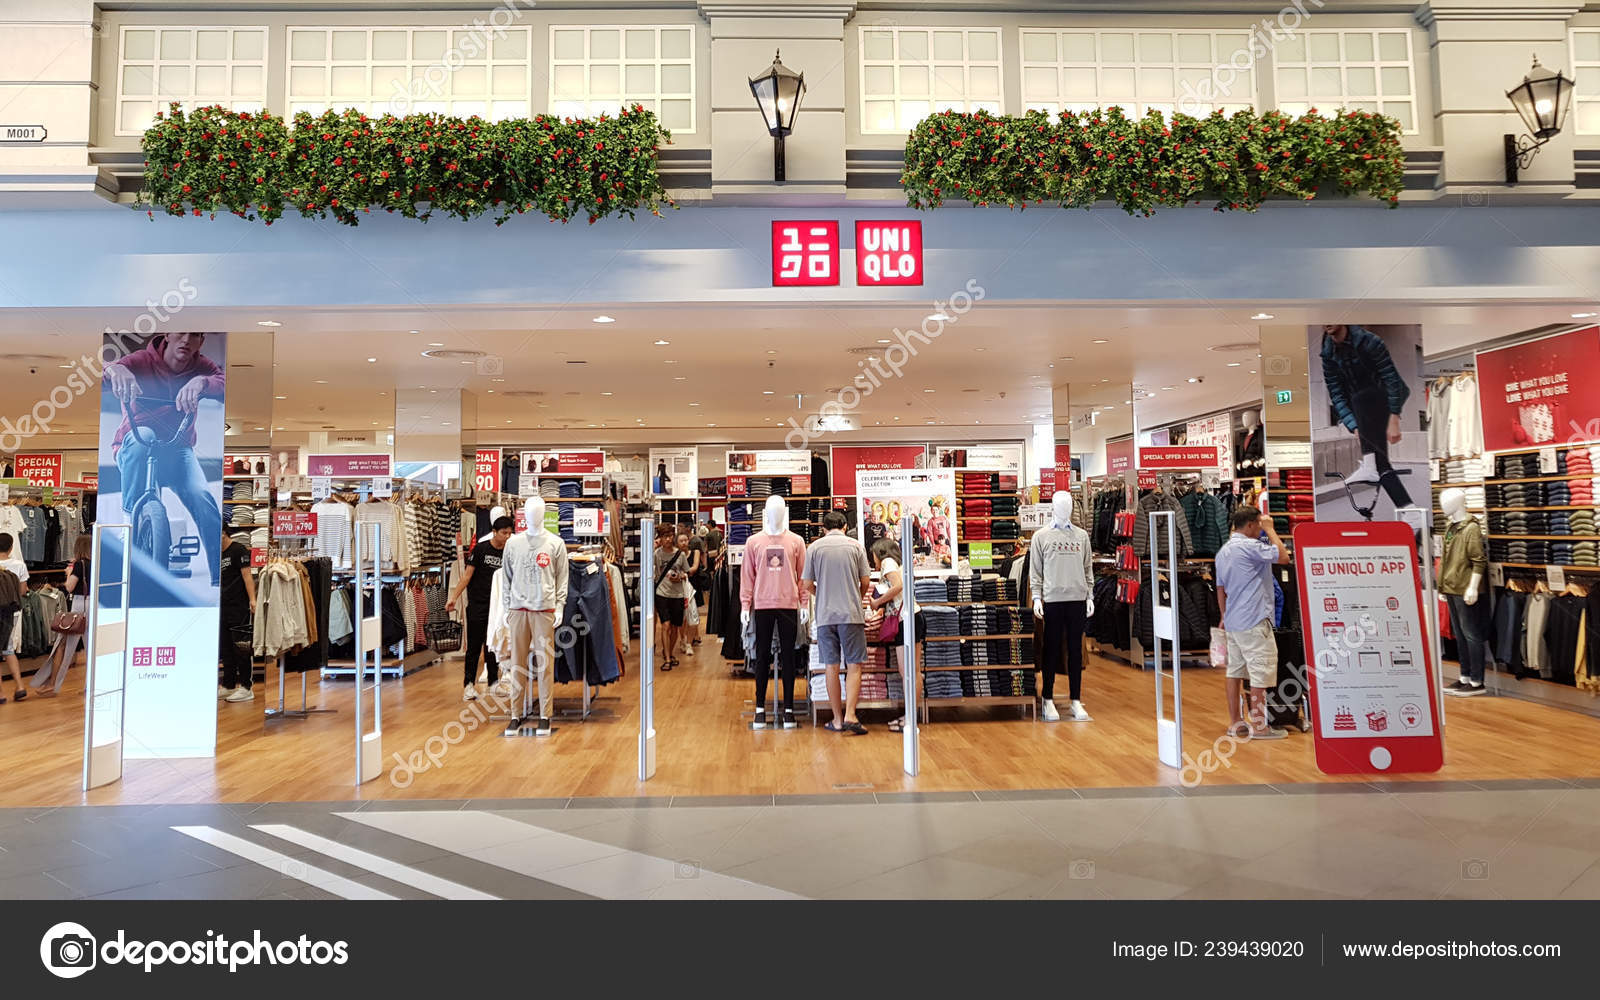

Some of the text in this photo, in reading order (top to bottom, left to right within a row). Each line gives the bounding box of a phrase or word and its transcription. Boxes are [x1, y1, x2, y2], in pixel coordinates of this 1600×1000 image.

[7, 128, 35, 138] M001
[18, 458, 58, 466] SPECIAL
[23, 468, 52, 477] OFFER
[1328, 562, 1405, 576] UNIQLO APP
